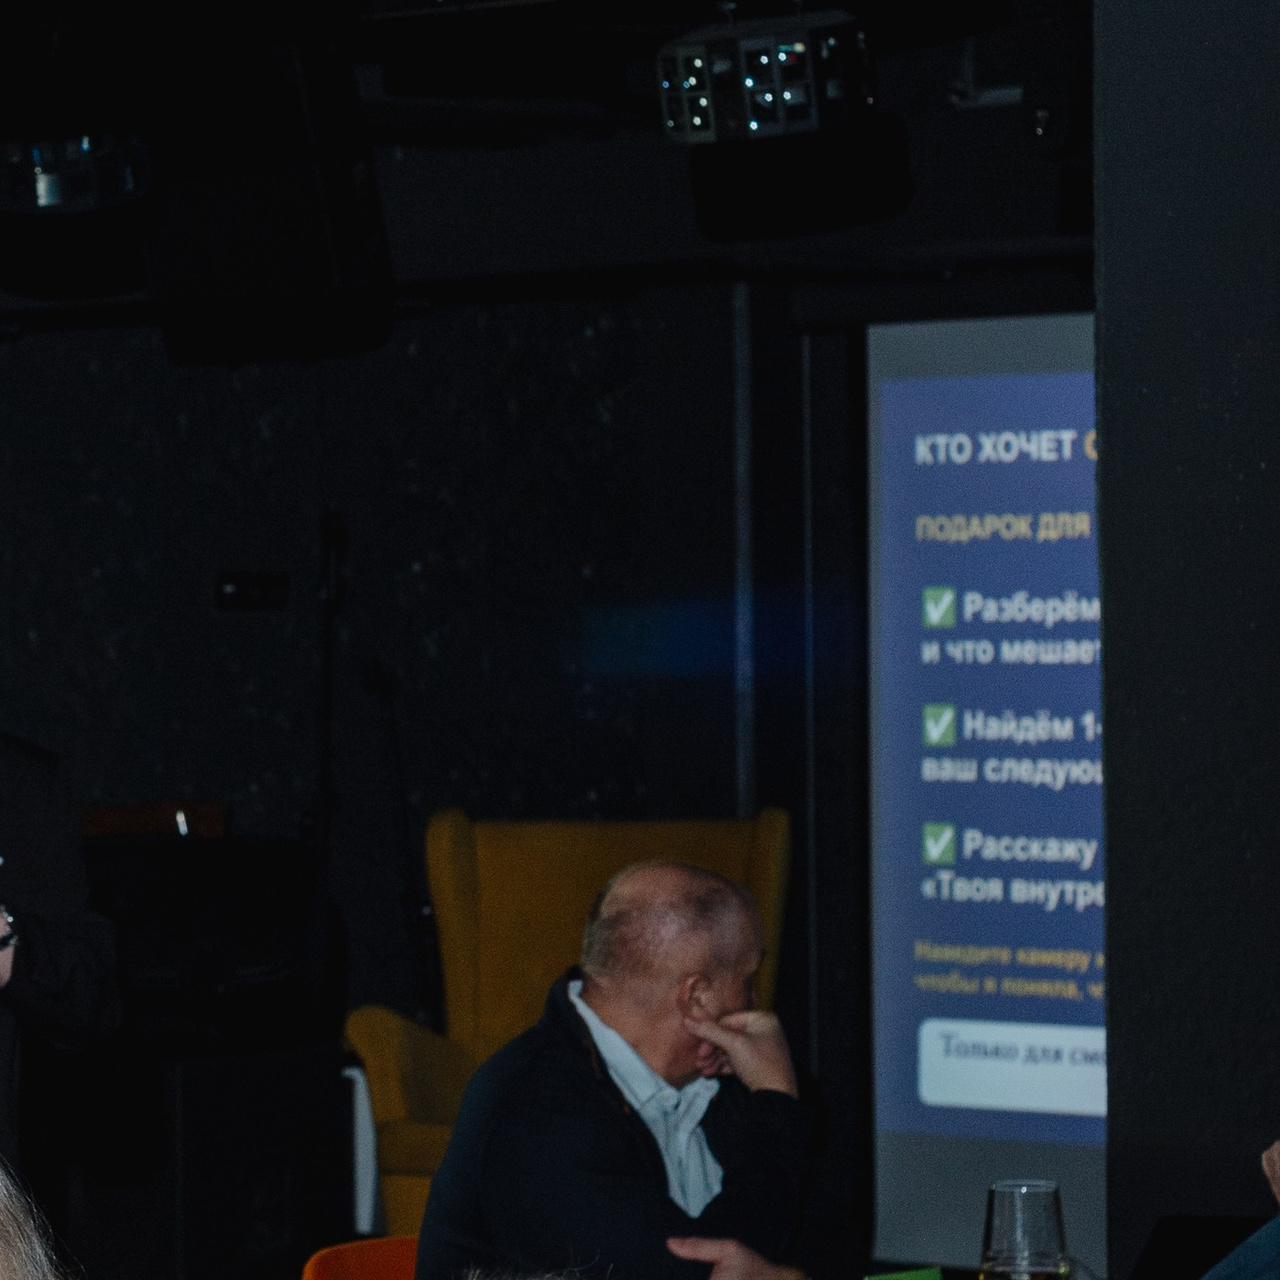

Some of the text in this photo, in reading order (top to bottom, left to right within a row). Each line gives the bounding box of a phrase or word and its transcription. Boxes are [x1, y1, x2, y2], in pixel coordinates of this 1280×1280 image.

[915, 432, 972, 465] КТО
[978, 429, 1077, 463] ХОЧЕТ
[915, 512, 1090, 543] ПОДАРОК ДЛЯ
[963, 590, 1101, 628] Разберём
[922, 641, 940, 664] и
[946, 640, 994, 664] что
[963, 709, 1073, 744] Найдём
[922, 758, 978, 781] ваш
[963, 828, 1096, 870] Расскажу
